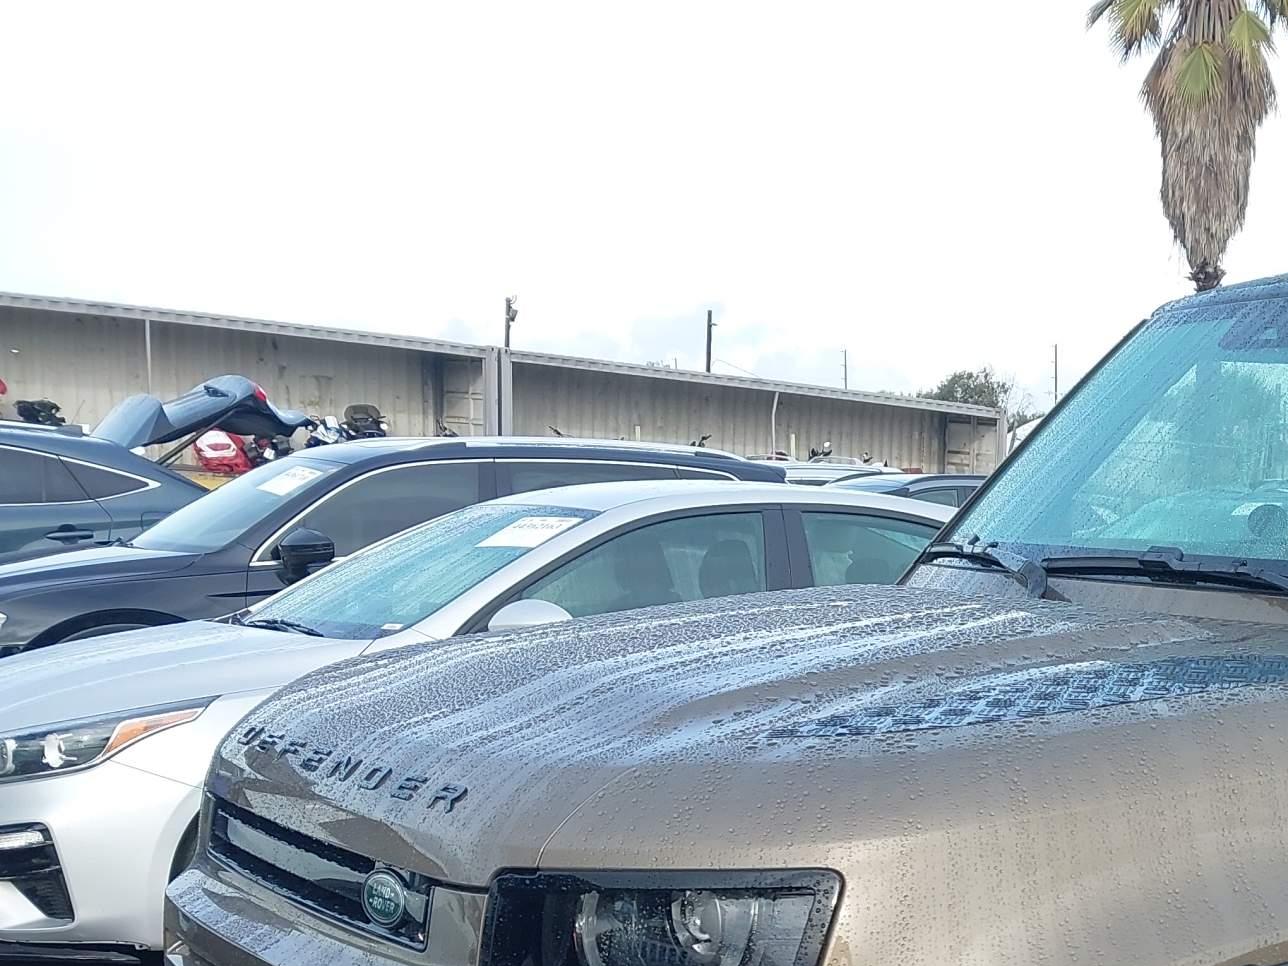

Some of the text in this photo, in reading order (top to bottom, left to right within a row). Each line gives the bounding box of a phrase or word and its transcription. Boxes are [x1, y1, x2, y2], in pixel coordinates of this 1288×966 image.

[237, 725, 469, 814] DEFENDER
[372, 882, 391, 898] LAND
[371, 896, 396, 913] ROVER
